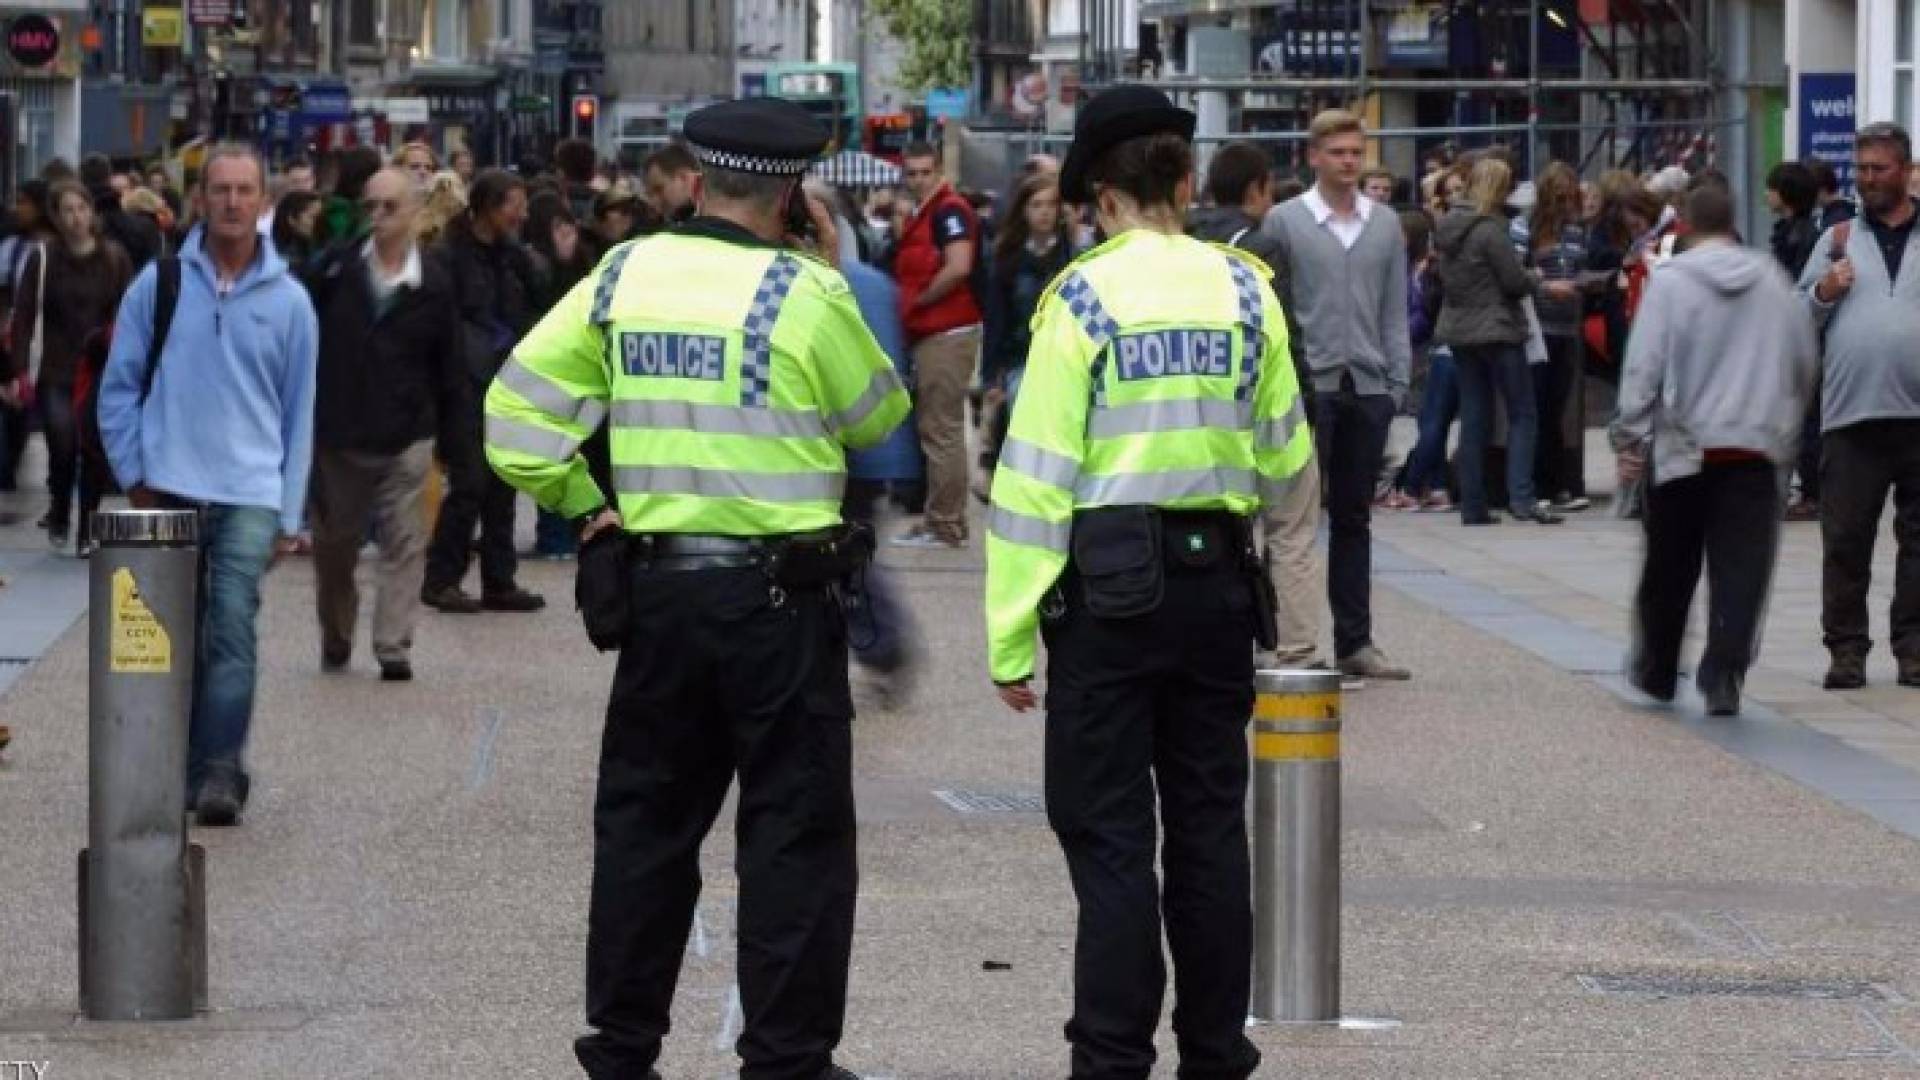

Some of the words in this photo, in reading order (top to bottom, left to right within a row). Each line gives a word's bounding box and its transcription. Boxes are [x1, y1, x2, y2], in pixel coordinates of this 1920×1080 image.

[9, 32, 54, 48] HMV
[624, 333, 722, 379] POLICE
[1120, 330, 1228, 379] POLICE
[126, 628, 158, 638] CCTV
